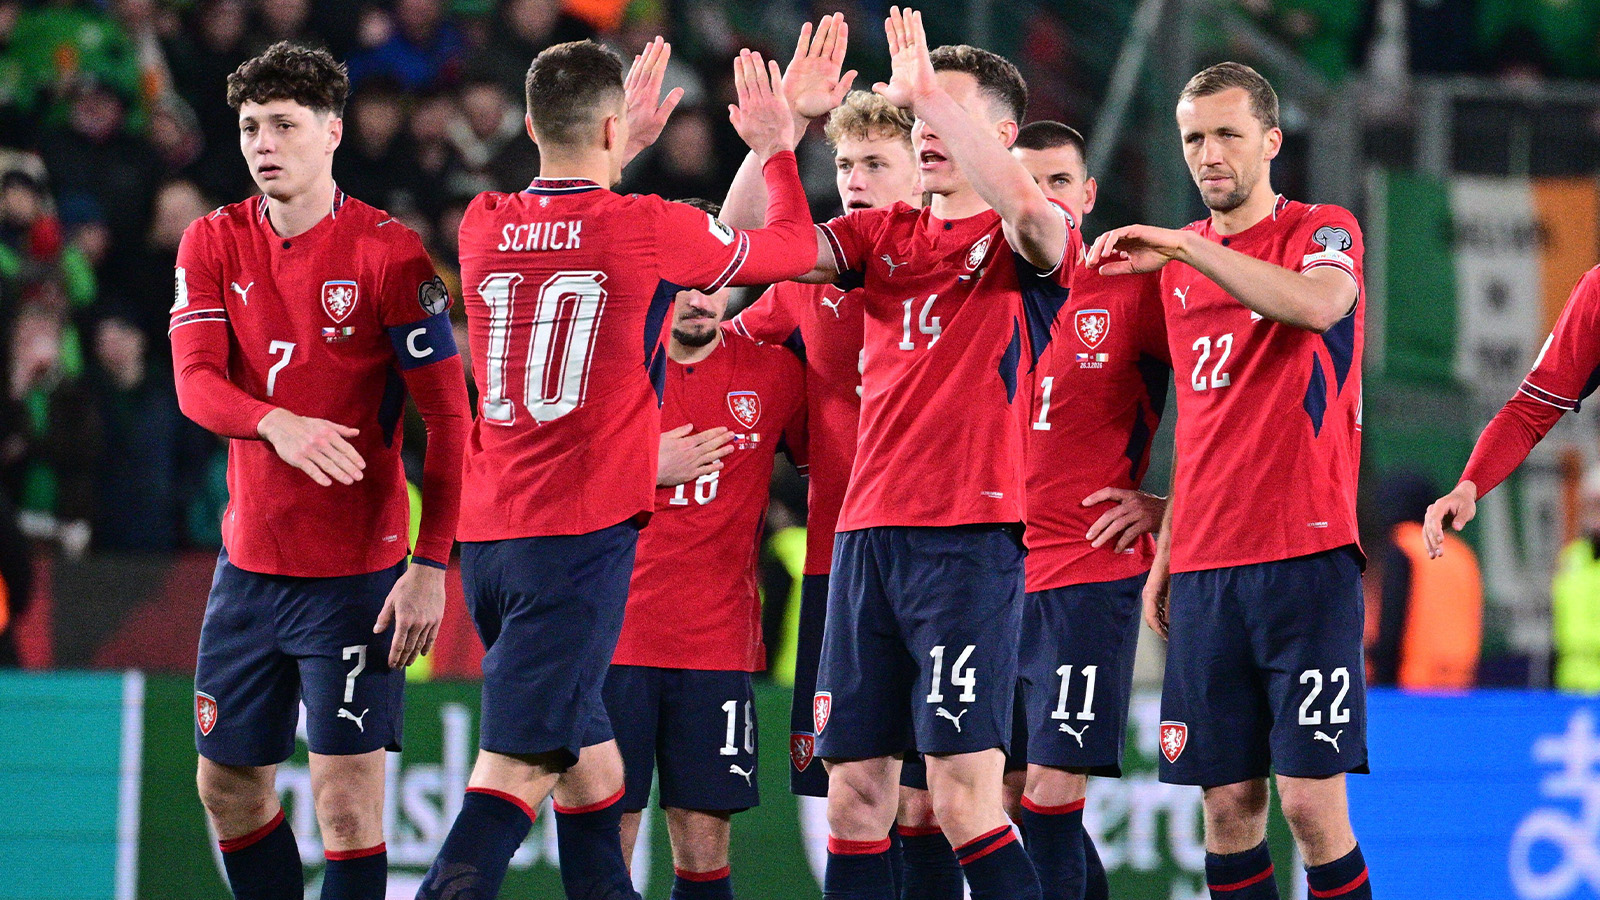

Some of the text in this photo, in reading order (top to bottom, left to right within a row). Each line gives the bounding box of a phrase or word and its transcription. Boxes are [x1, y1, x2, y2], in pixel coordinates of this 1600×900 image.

[498, 220, 582, 251] SCHICK
[406, 327, 433, 358] C
[477, 271, 608, 426] 10
[899, 294, 941, 350] 14
[267, 340, 297, 396] 7
[1192, 333, 1233, 391] 22
[1033, 376, 1054, 430] 1
[342, 645, 367, 702] 7
[927, 645, 976, 703] 14
[1051, 665, 1097, 720] 11
[1299, 667, 1350, 725] 22
